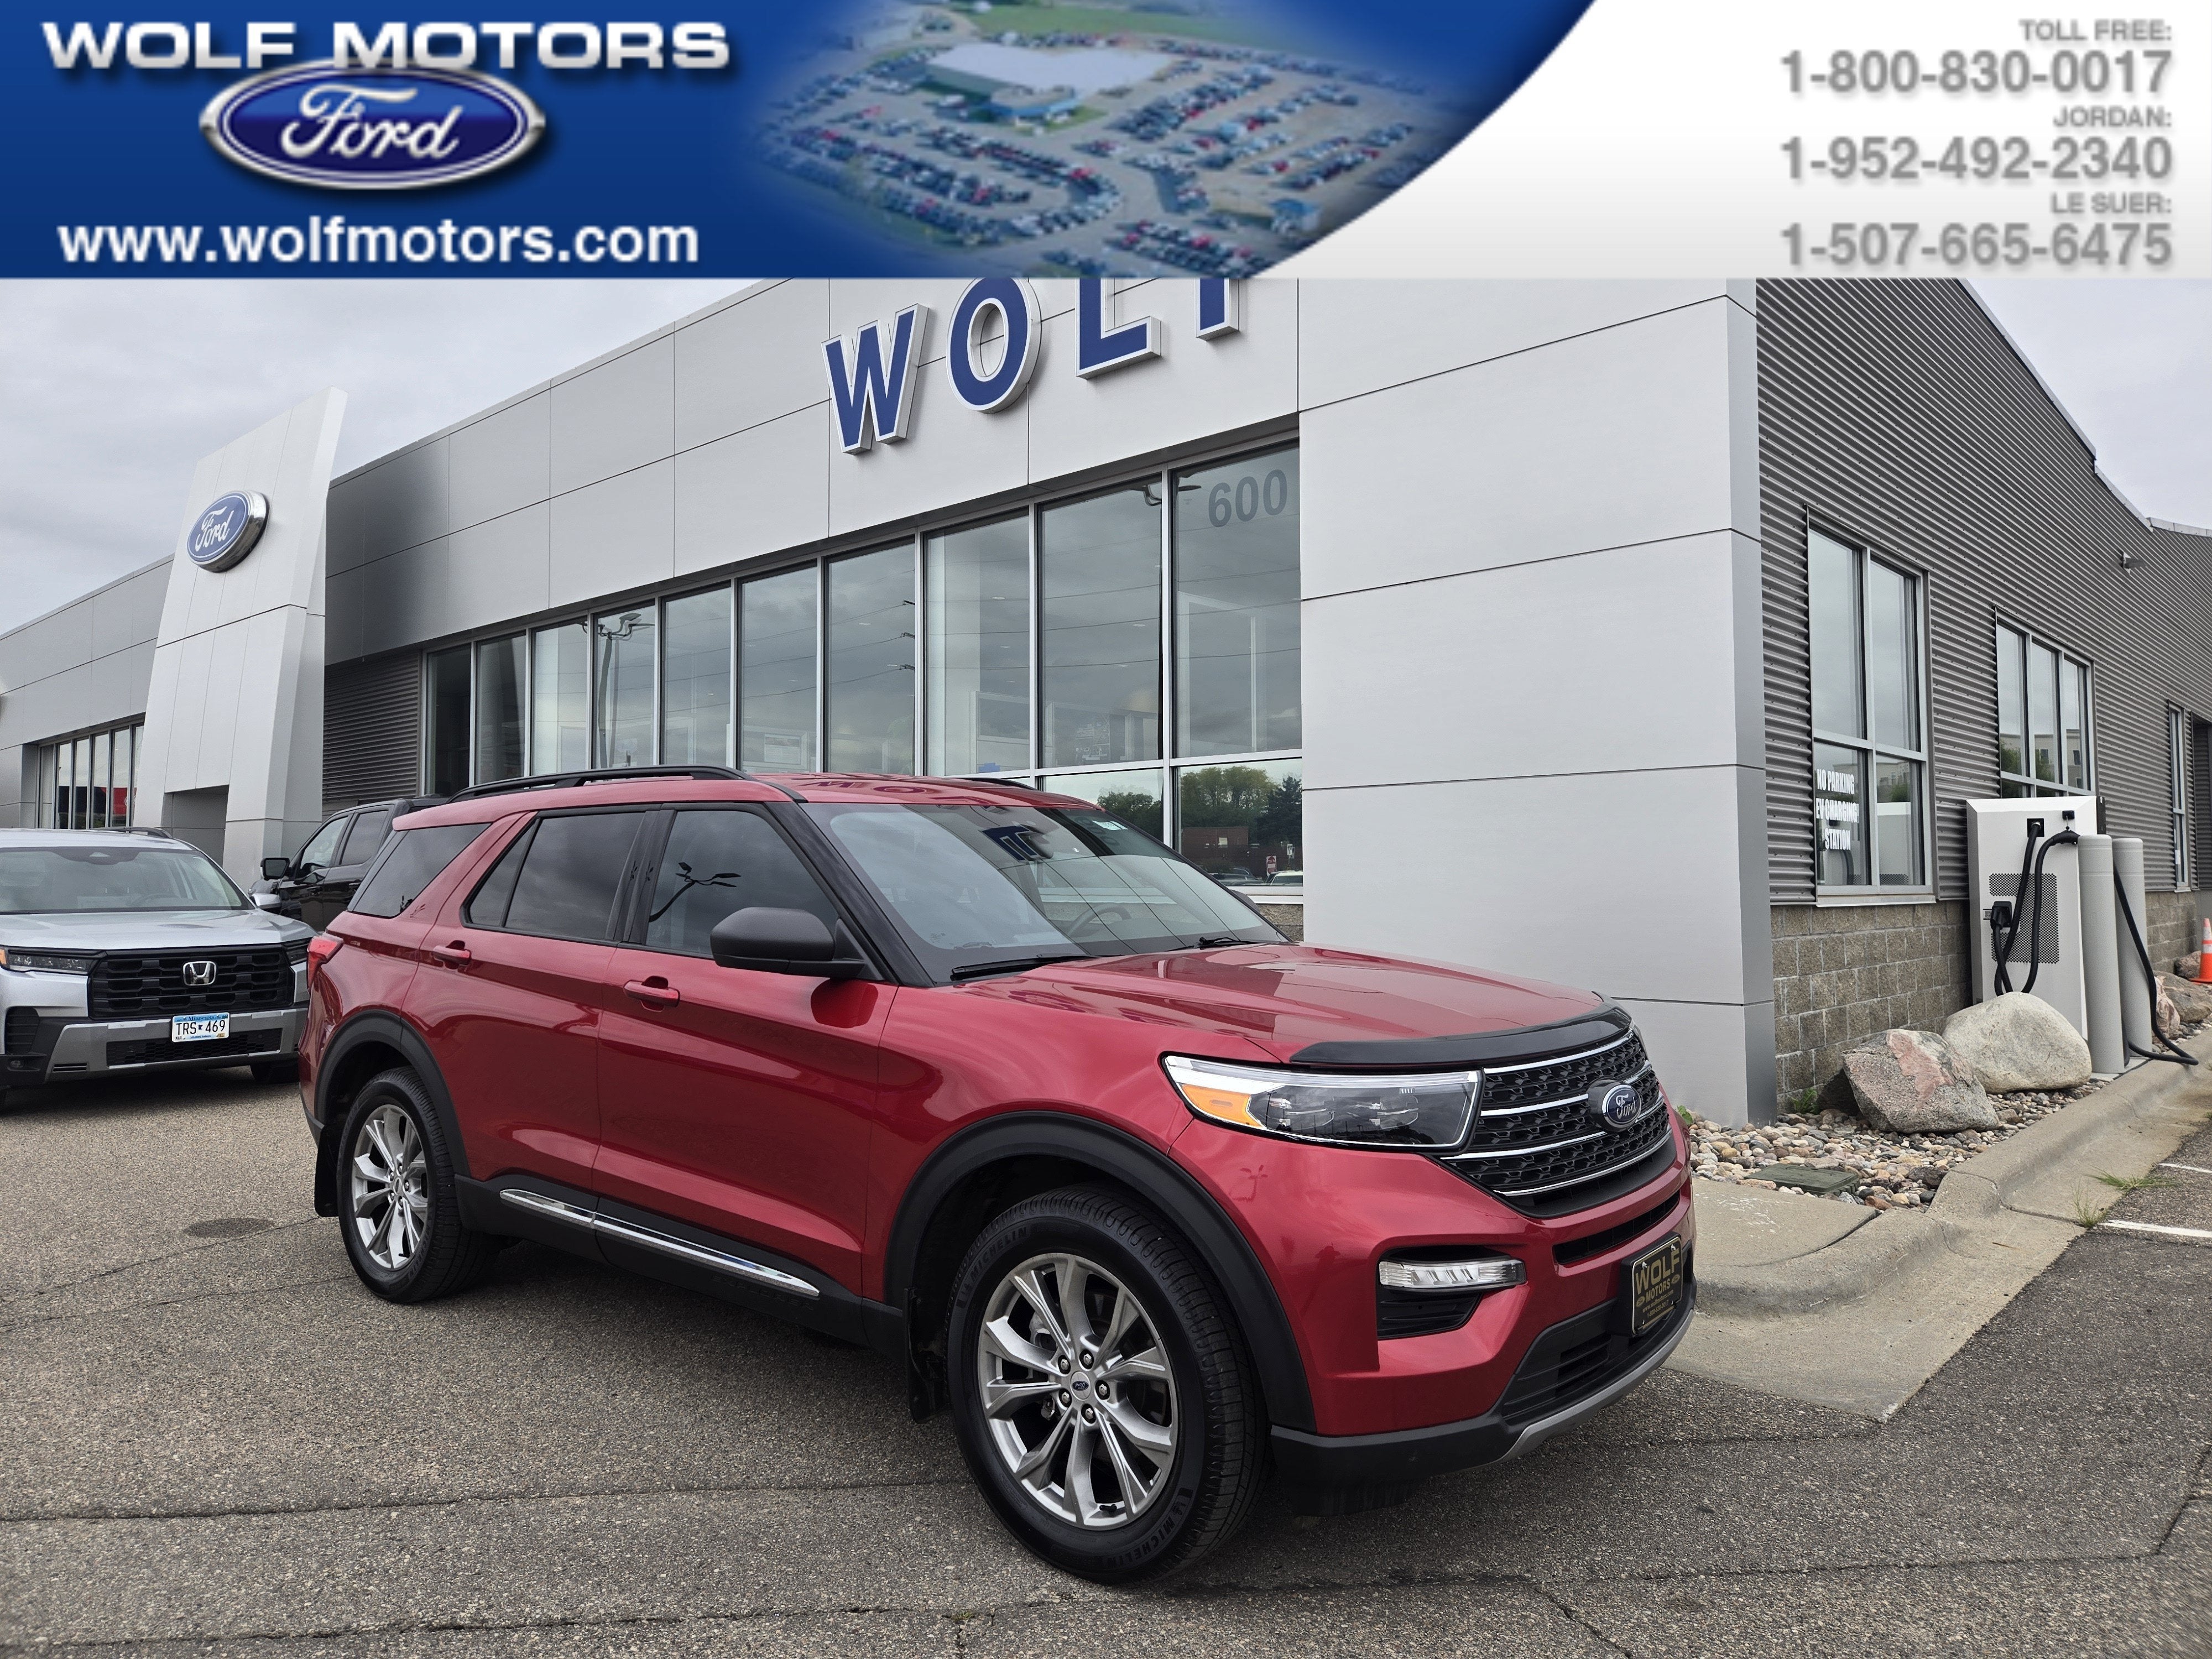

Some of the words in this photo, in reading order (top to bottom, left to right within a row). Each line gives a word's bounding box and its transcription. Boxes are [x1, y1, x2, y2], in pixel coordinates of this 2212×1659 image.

[1208, 469, 1287, 528] 600
[195, 505, 234, 552] Ford
[1817, 768, 1827, 791] NO
[1827, 770, 1855, 795] PARKING
[1815, 797, 1824, 820] EV
[1825, 799, 1858, 823] CHARGING
[1825, 828, 1851, 851] STATION
[176, 1021, 196, 1035] TRS
[205, 1020, 226, 1033] 469
[1616, 1093, 1637, 1119] Ford
[969, 1226, 1027, 1283] MICHELIN
[1635, 1248, 1679, 1295] WOLF
[1646, 1278, 1670, 1303] MOTORS
[1107, 1516, 1176, 1568] MICHELIN
